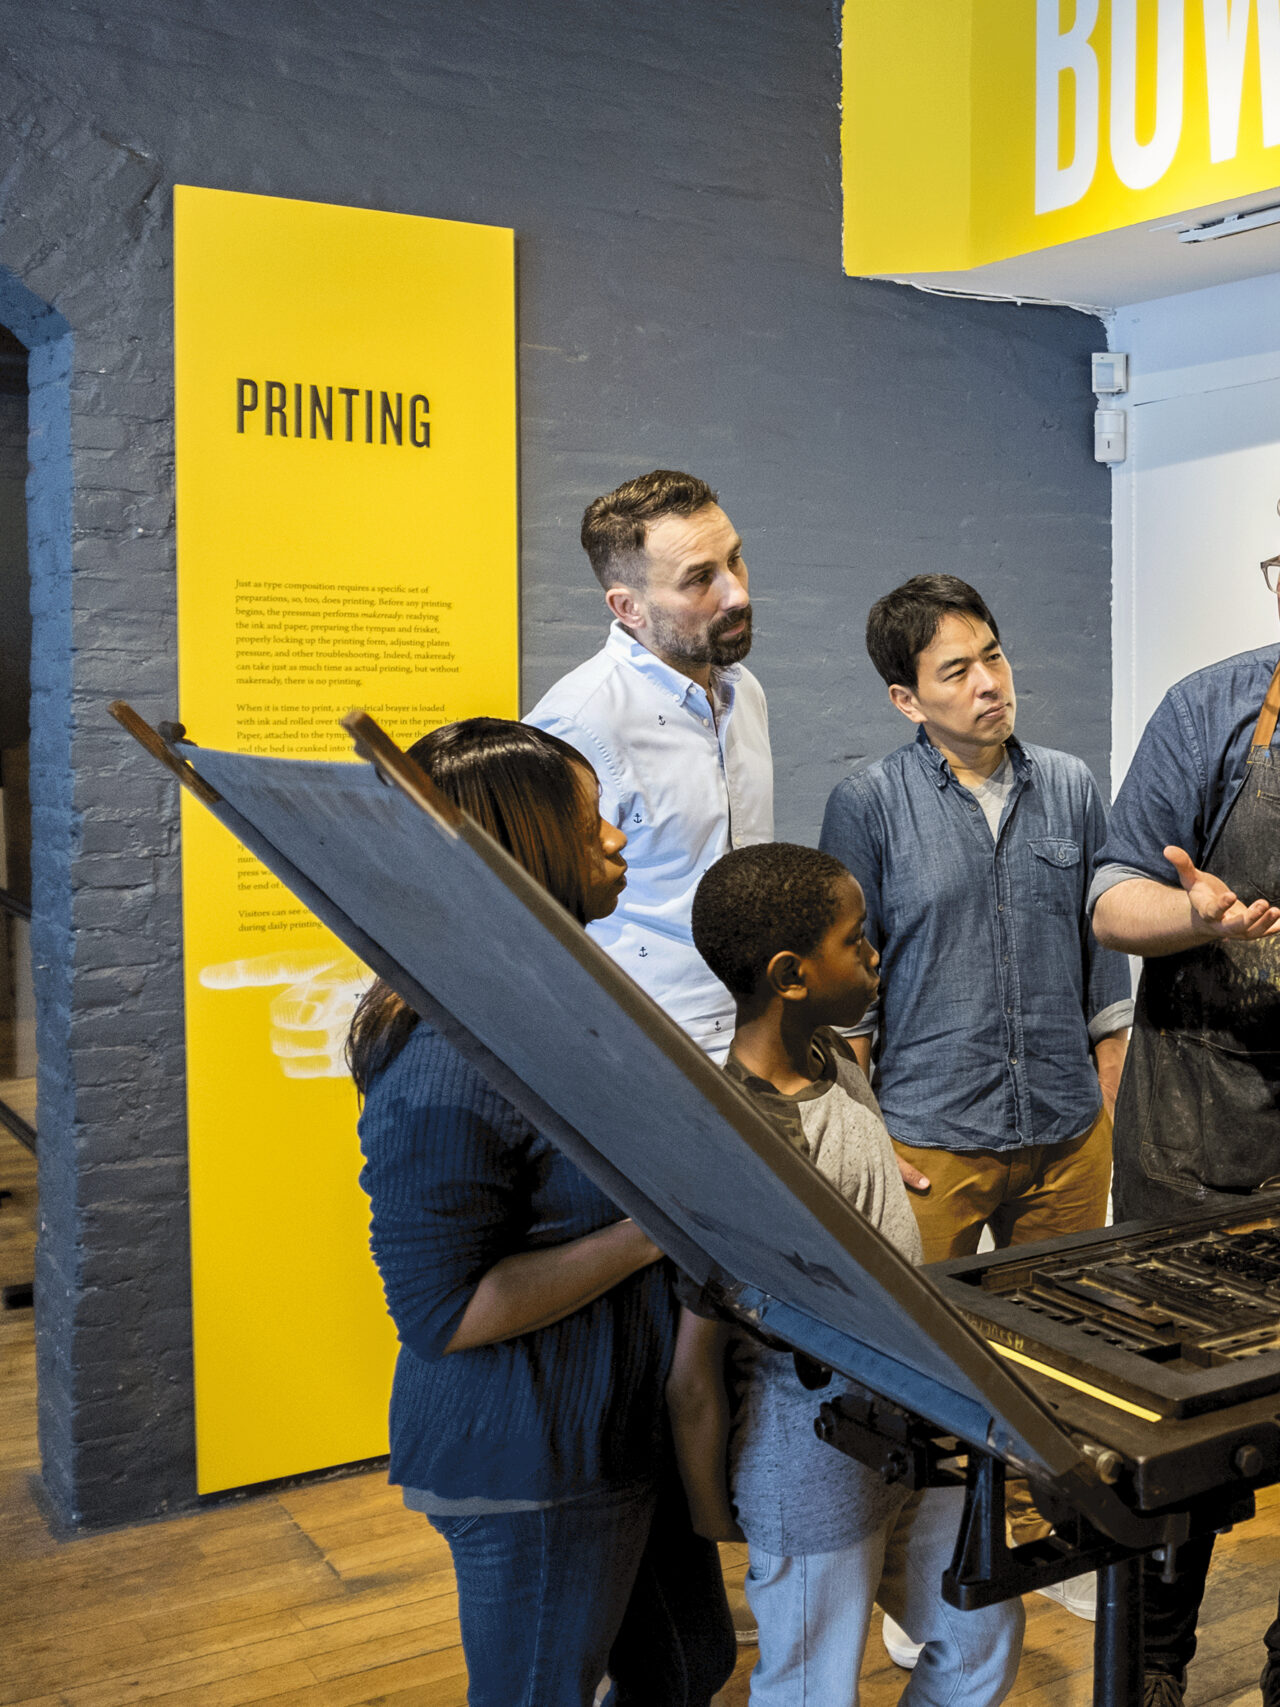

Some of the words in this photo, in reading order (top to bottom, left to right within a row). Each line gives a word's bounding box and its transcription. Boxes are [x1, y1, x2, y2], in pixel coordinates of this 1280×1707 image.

[236, 378, 431, 448] PRINTING
[234, 579, 251, 589] Just
[264, 581, 282, 590] type
[284, 582, 335, 591] composition
[338, 584, 368, 593] requires
[377, 584, 406, 594] specific
[322, 596, 340, 604] does
[378, 598, 404, 606] Before
[406, 600, 418, 608] any
[421, 600, 452, 609] printing
[266, 608, 280, 616] the
[282, 610, 320, 618] pressman
[323, 610, 360, 619] performs
[406, 612, 440, 622] readying
[266, 622, 282, 630] and
[310, 624, 350, 632] preparing
[351, 624, 364, 632] the
[366, 626, 396, 634] tympan
[236, 636, 272, 644] properly
[273, 636, 304, 646] locking
[306, 638, 316, 646] up
[318, 636, 330, 644] the
[333, 637, 364, 647] printing
[390, 638, 424, 648] adjusting
[426, 639, 450, 648] platen
[292, 650, 314, 658] other
[414, 652, 456, 662] makeready
[252, 662, 270, 670] take
[271, 664, 286, 672] just
[354, 664, 378, 672] actual
[414, 664, 428, 672] but
[430, 665, 460, 673] without
[284, 676, 306, 684] there
[236, 704, 262, 712] When
[264, 704, 270, 712] it
[272, 704, 279, 712] is
[280, 704, 300, 712] time
[385, 704, 409, 713] brayer
[412, 704, 418, 712] is
[420, 704, 444, 712] loaded
[380, 718, 398, 727] type
[409, 717, 421, 725] the
[424, 719, 442, 727] press
[264, 731, 298, 739] attached
[254, 745, 268, 753] the
[270, 745, 285, 753] bed
[296, 744, 328, 753] cranked
[238, 870, 259, 879] press
[238, 882, 252, 891] the
[253, 882, 268, 890] end
[238, 910, 270, 918] Visitors
[238, 923, 266, 933] during
[268, 922, 288, 931] daily
